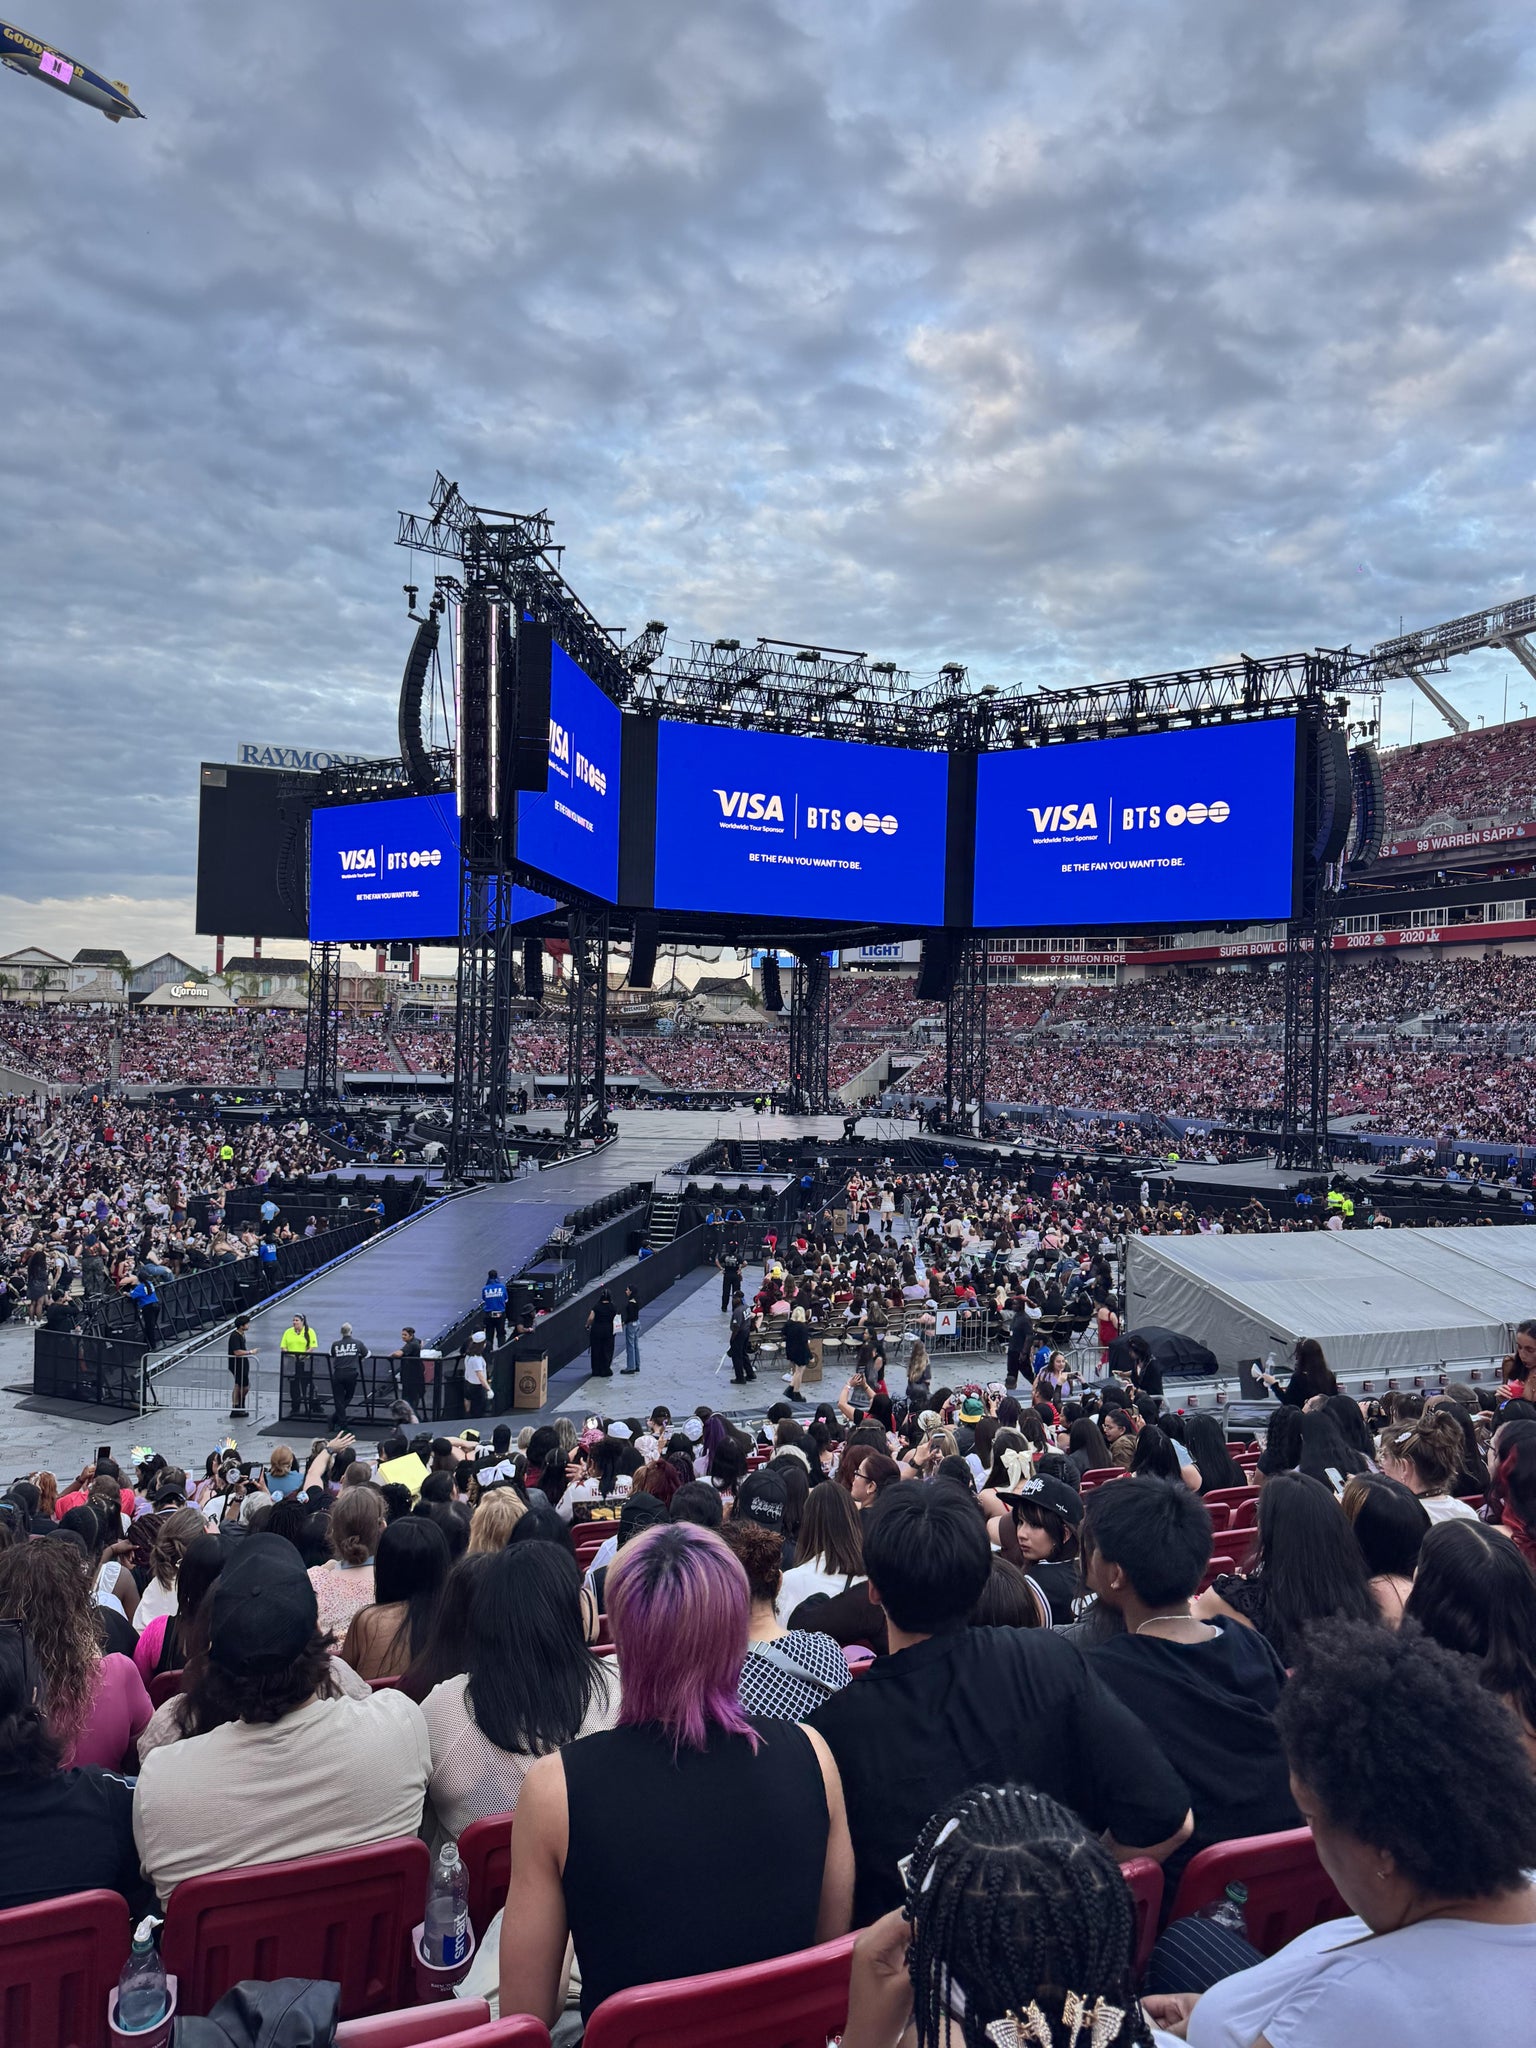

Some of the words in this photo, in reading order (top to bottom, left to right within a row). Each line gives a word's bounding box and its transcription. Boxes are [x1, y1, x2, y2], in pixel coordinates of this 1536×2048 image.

[575, 751, 589, 784] BTS
[712, 789, 784, 821] VISA
[719, 822, 749, 830] Worldwide
[807, 807, 841, 830] BTS
[1026, 803, 1098, 833] VISA
[1122, 806, 1160, 831] BTS
[1032, 837, 1061, 845] Worldwide
[1416, 840, 1429, 852] 99
[1431, 832, 1480, 850] WARREN
[1482, 826, 1514, 842] SAPP
[338, 849, 376, 870] VISA
[387, 852, 407, 870] BTS
[749, 853, 760, 861] BE
[761, 854, 777, 863] THE
[778, 855, 794, 864] FAN
[795, 857, 812, 866] YOU
[813, 858, 837, 868] WANT
[838, 860, 849, 869] TO
[850, 861, 862, 870] BE.
[1062, 864, 1072, 872] BE
[1073, 863, 1090, 872] THE
[1091, 862, 1108, 871] FAN
[1108, 861, 1128, 870] YOU
[1128, 859, 1155, 869] WANT
[1156, 858, 1169, 867] TO
[1171, 857, 1185, 866] BE.
[1347, 935, 1371, 947] 2002
[1400, 930, 1425, 943] 2020
[862, 945, 900, 956] LIGHT
[1220, 945, 1248, 957] SUPER
[1250, 943, 1277, 955] BOWL
[1278, 937, 1335, 952] CHMPINS
[1050, 955, 1061, 963] 97
[1063, 955, 1101, 963] SIMEON
[1103, 955, 1126, 963] RICE
[170, 985, 208, 997] Corona
[942, 1315, 950, 1326] A
[454, 1909, 468, 1959] smart
